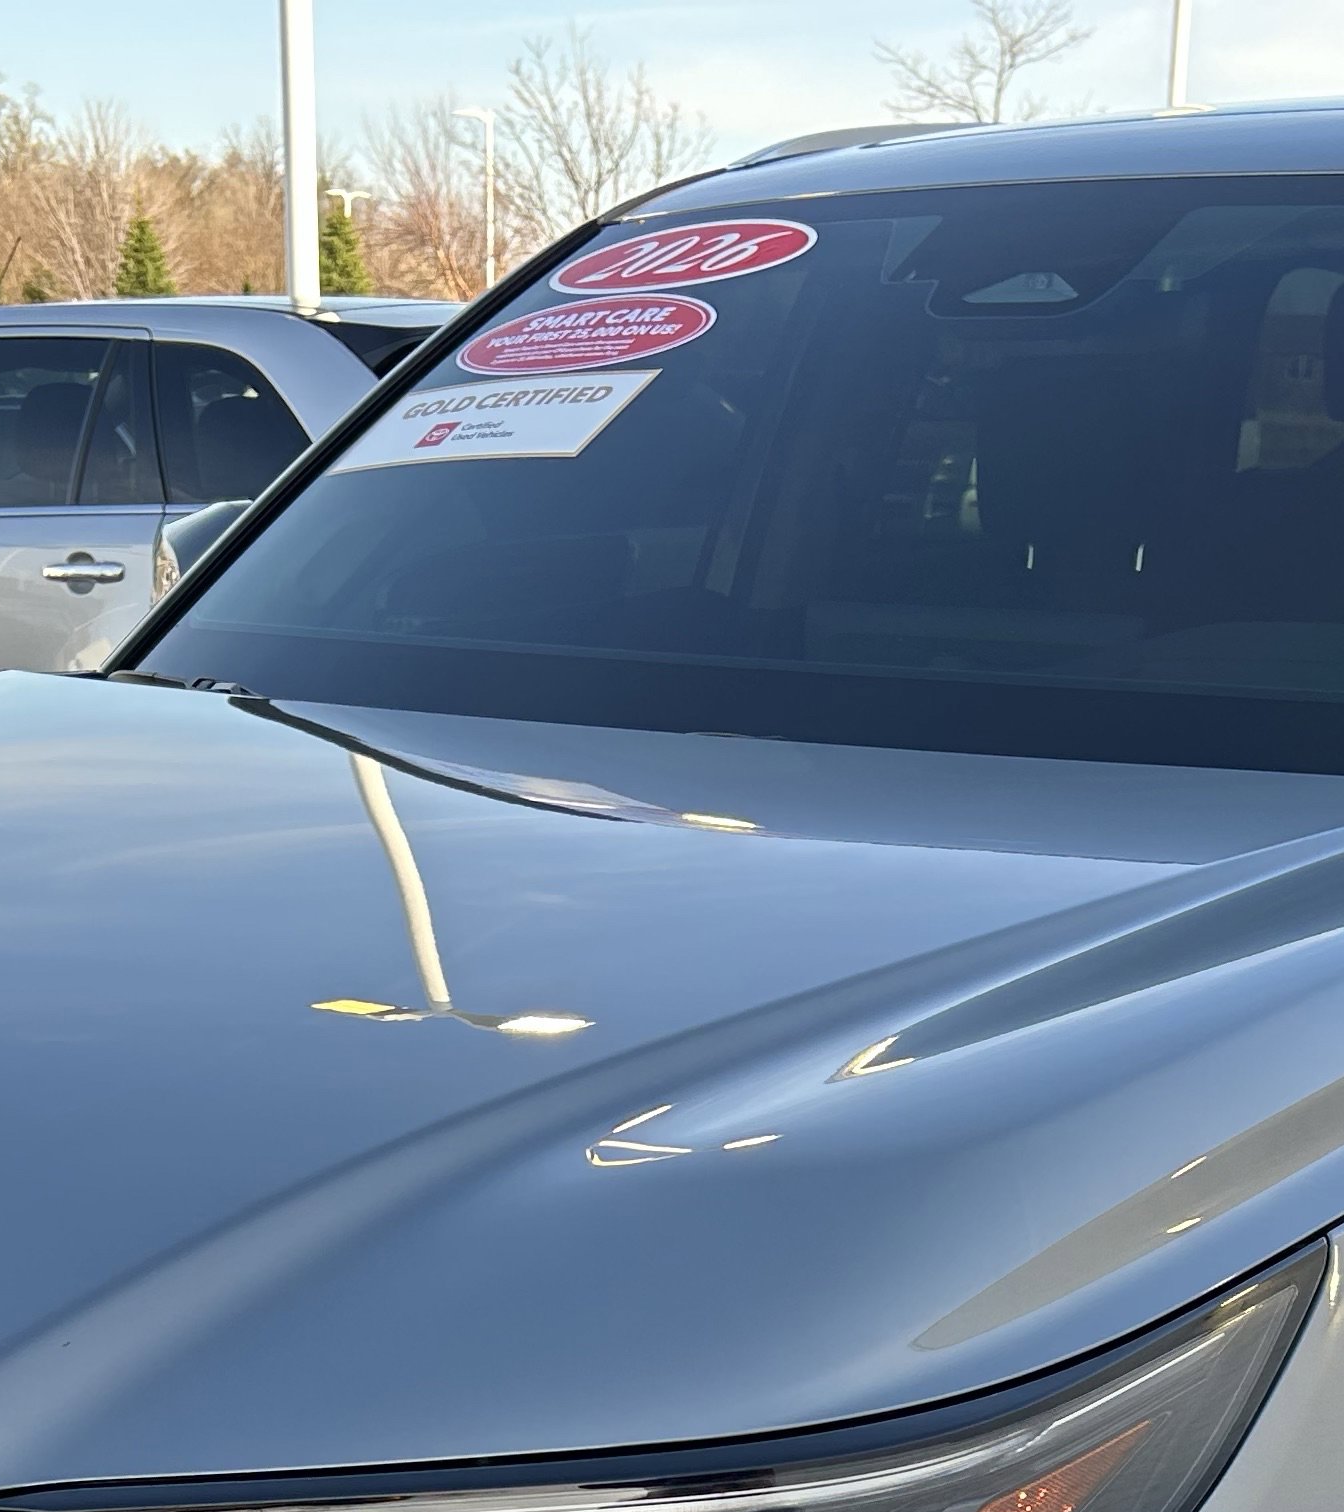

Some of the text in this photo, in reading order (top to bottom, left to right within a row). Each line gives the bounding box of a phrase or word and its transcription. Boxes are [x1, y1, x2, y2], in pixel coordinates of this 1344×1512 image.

[575, 231, 793, 284] 2026
[523, 306, 677, 332] SMART CARE
[527, 328, 573, 342] FIRST
[620, 323, 652, 336] ON
[403, 386, 614, 420] GOLD CERTIFIED
[461, 420, 504, 431] Certified
